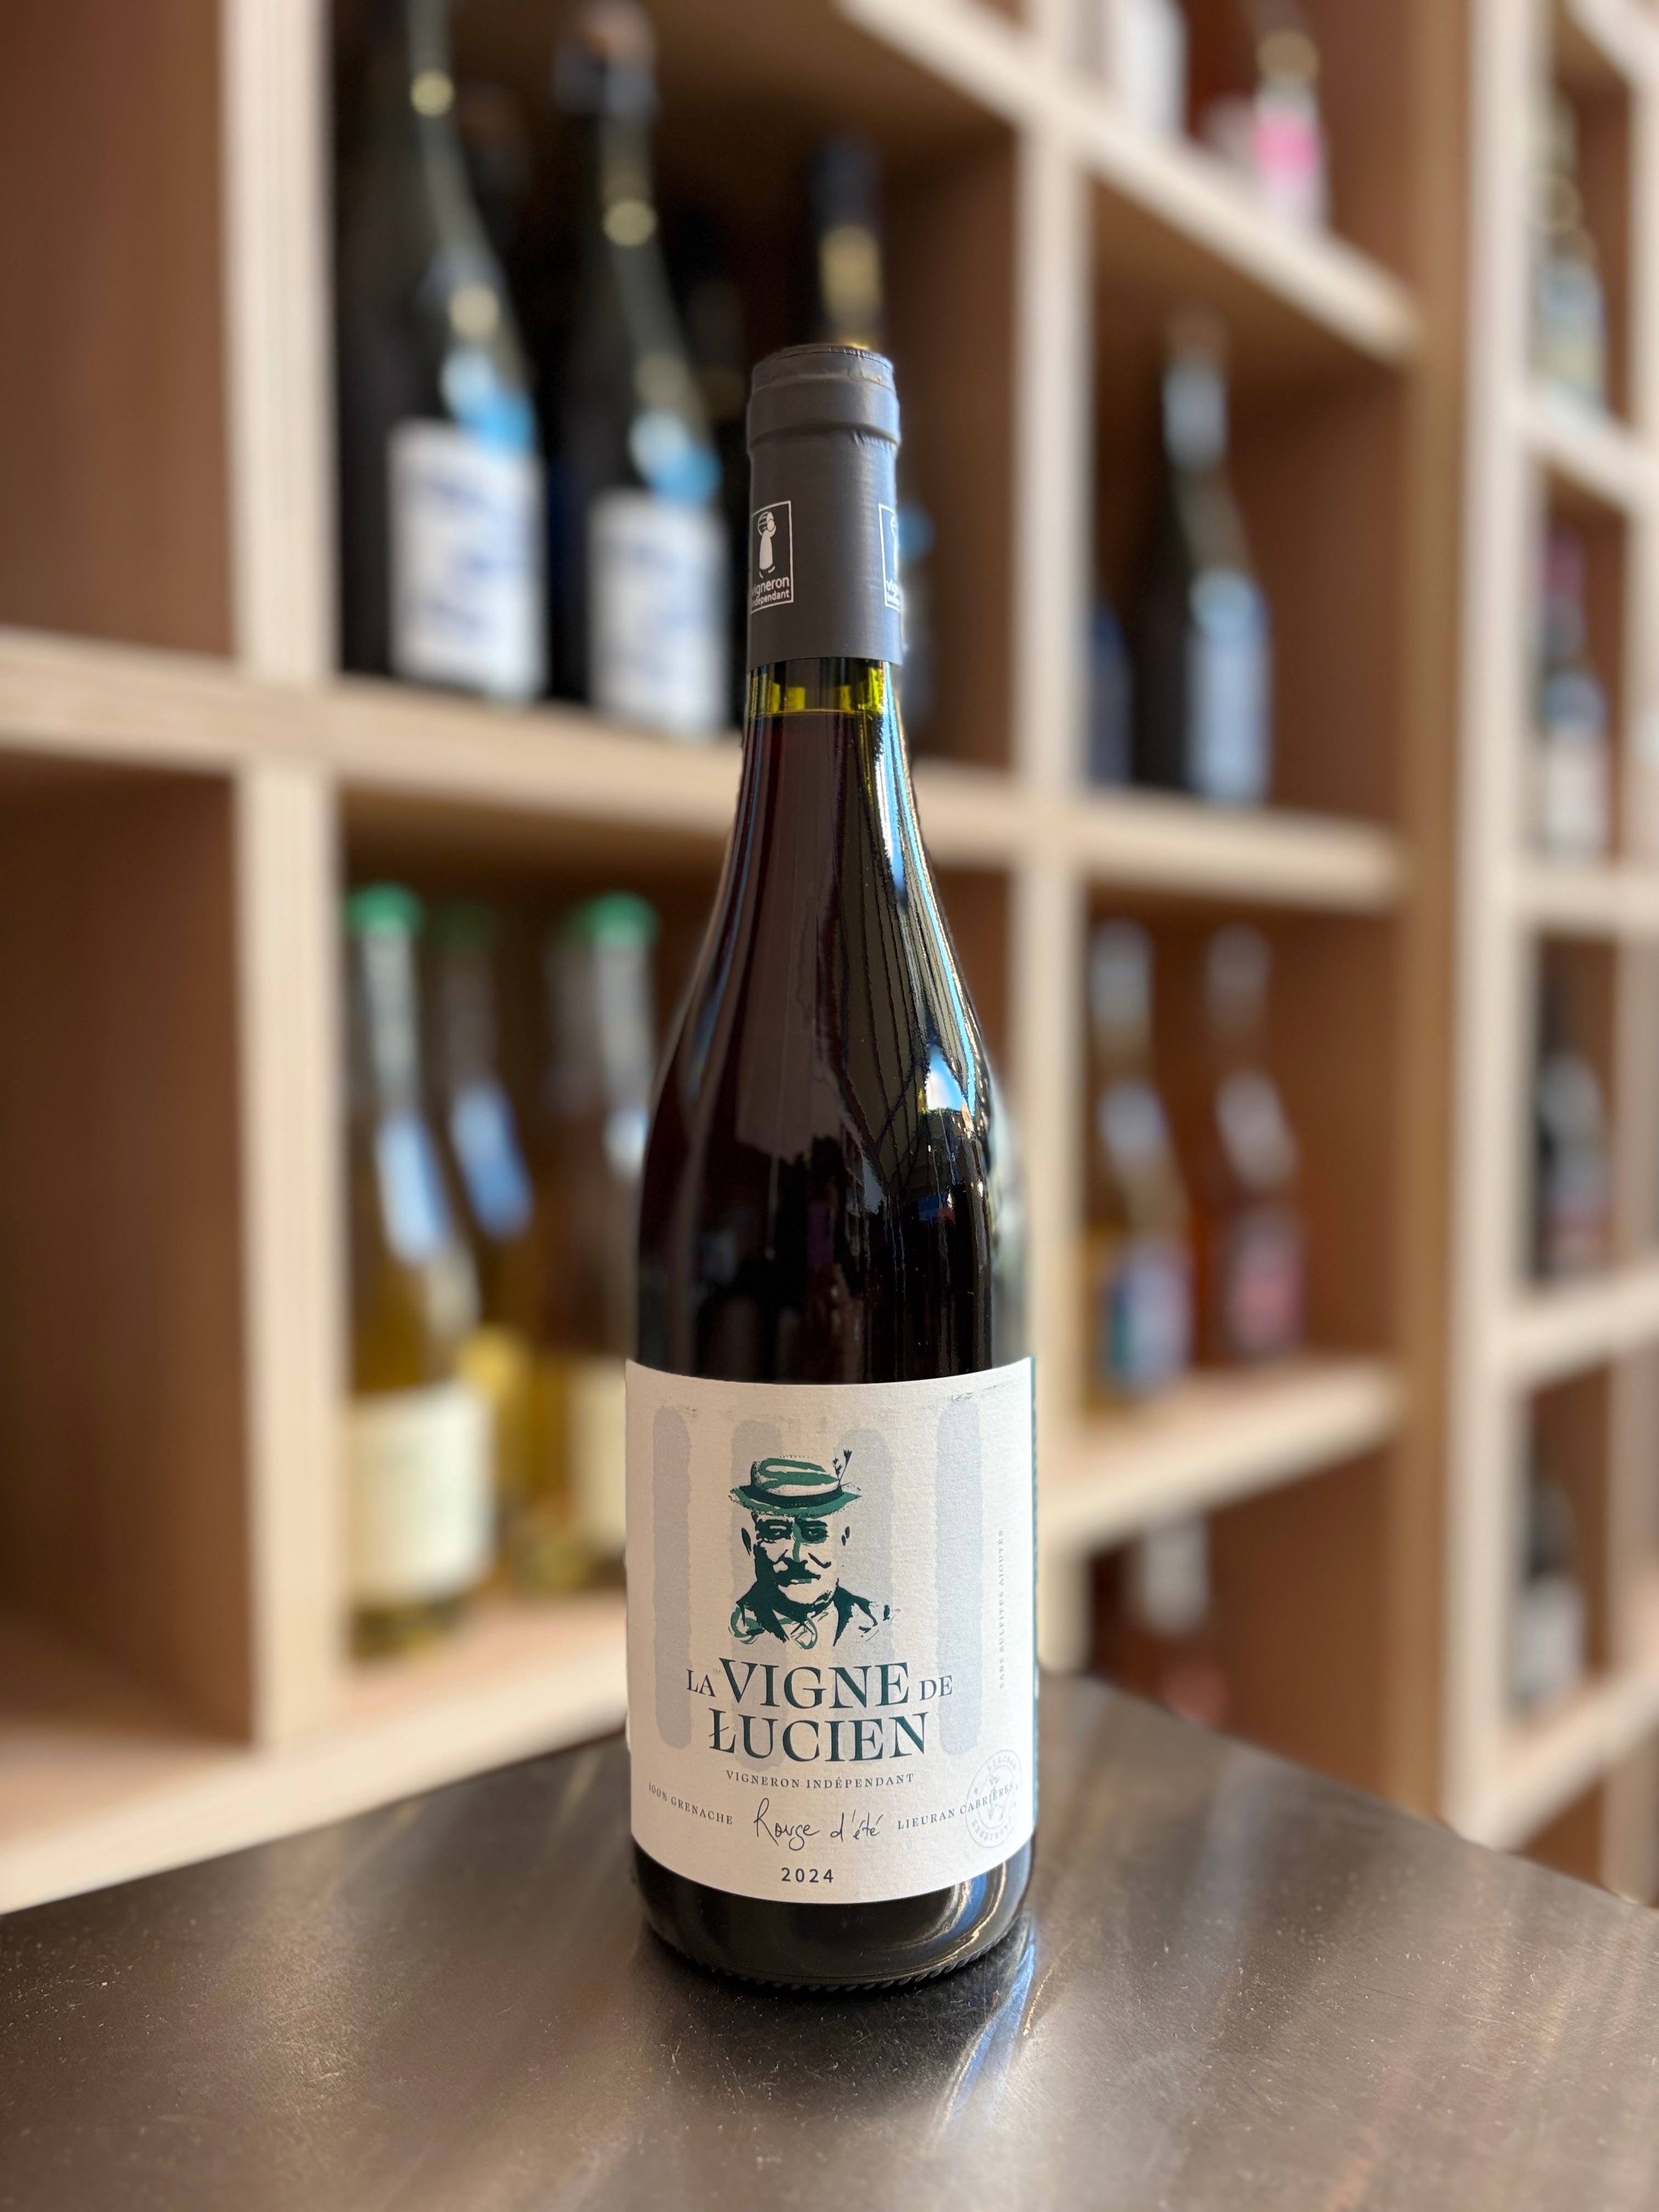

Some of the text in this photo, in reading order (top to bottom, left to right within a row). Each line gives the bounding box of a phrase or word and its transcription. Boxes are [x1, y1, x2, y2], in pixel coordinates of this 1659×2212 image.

[686, 1657, 953, 1709] LA VIGNE DE
[726, 1770, 915, 1789] VIGNERON INDÉPENDANT
[671, 1796, 733, 1825] GRENACHE
[897, 1808, 956, 1830] LIEURAN
[753, 1797, 884, 1852] Rouge d'été
[781, 1867, 834, 1883] 2024
